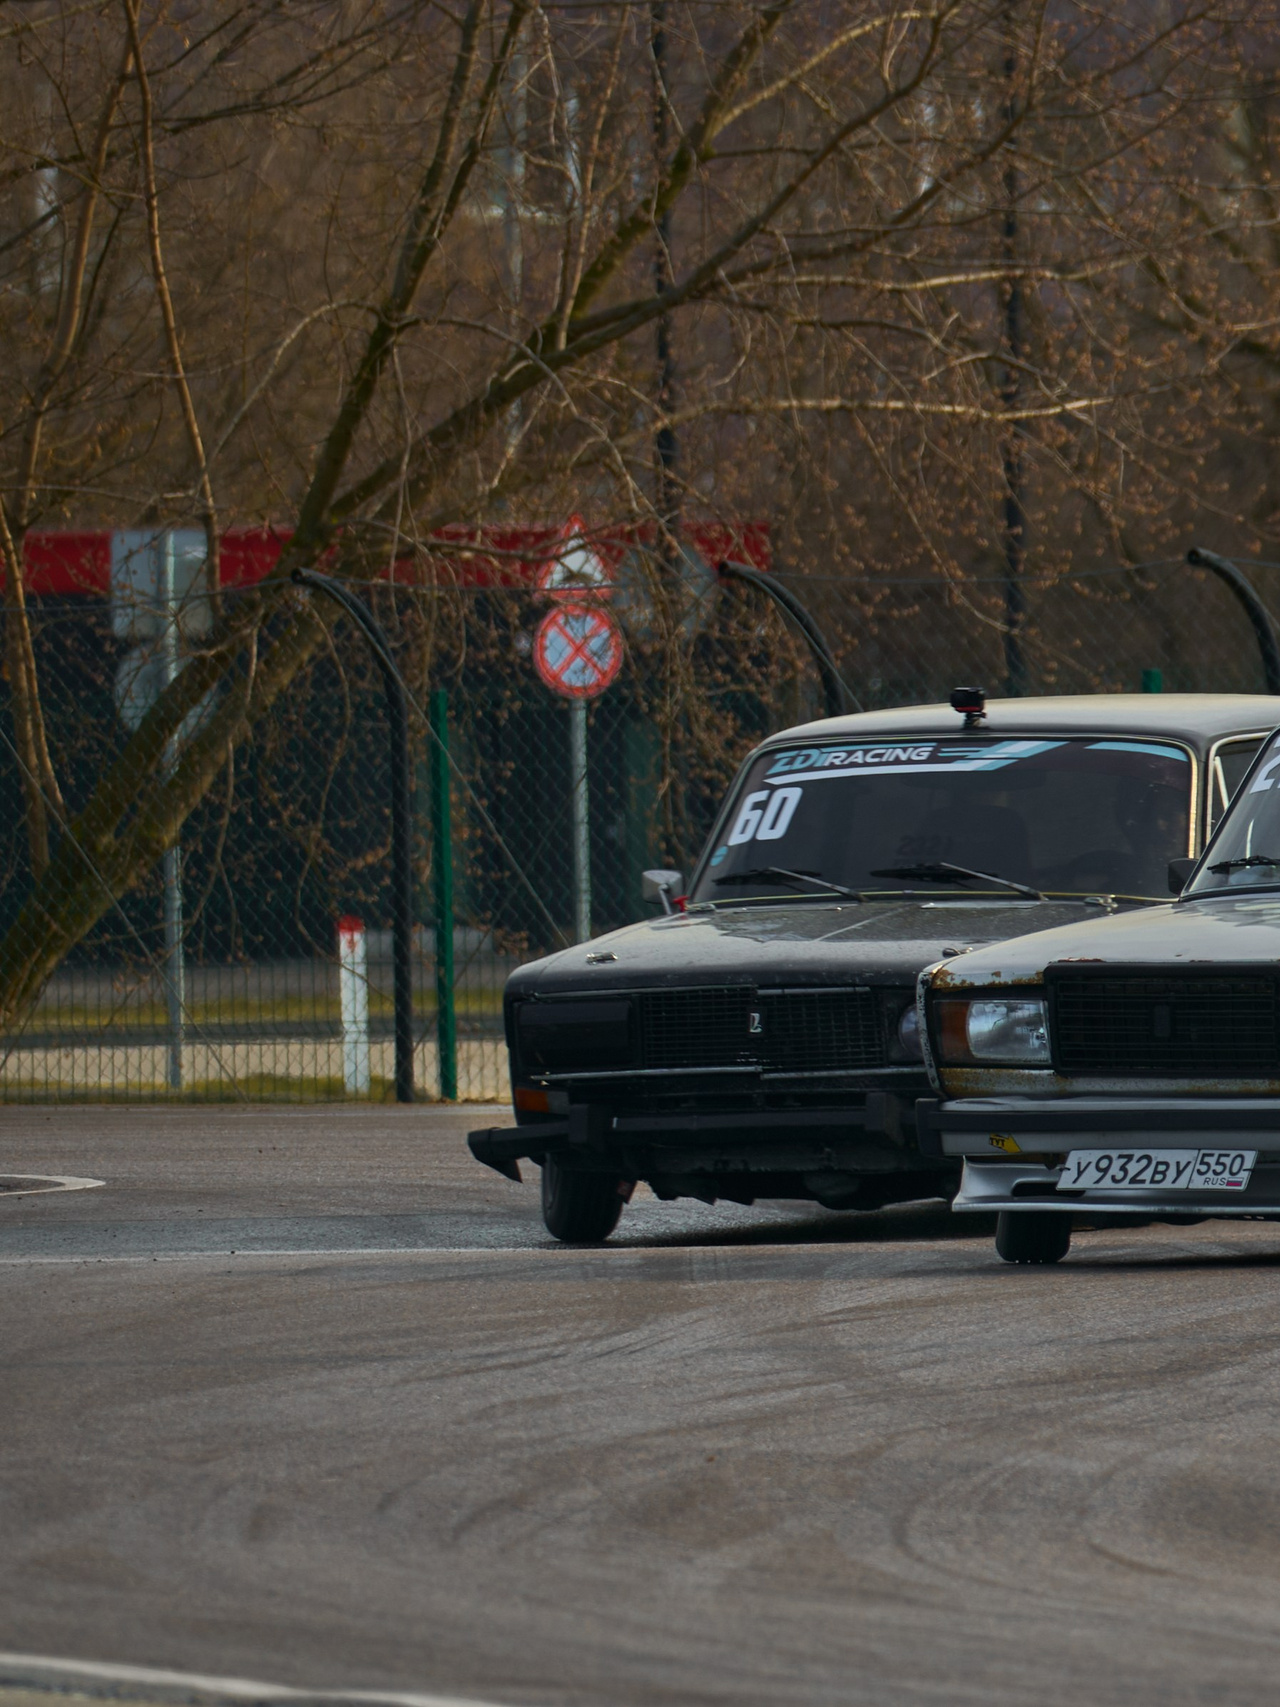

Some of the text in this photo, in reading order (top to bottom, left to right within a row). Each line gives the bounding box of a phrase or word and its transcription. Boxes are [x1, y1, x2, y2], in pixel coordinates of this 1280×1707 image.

[823, 746, 934, 767] RACING
[727, 786, 803, 847] 60
[1196, 1153, 1245, 1177] 550
[1203, 1177, 1227, 1186] RUS
